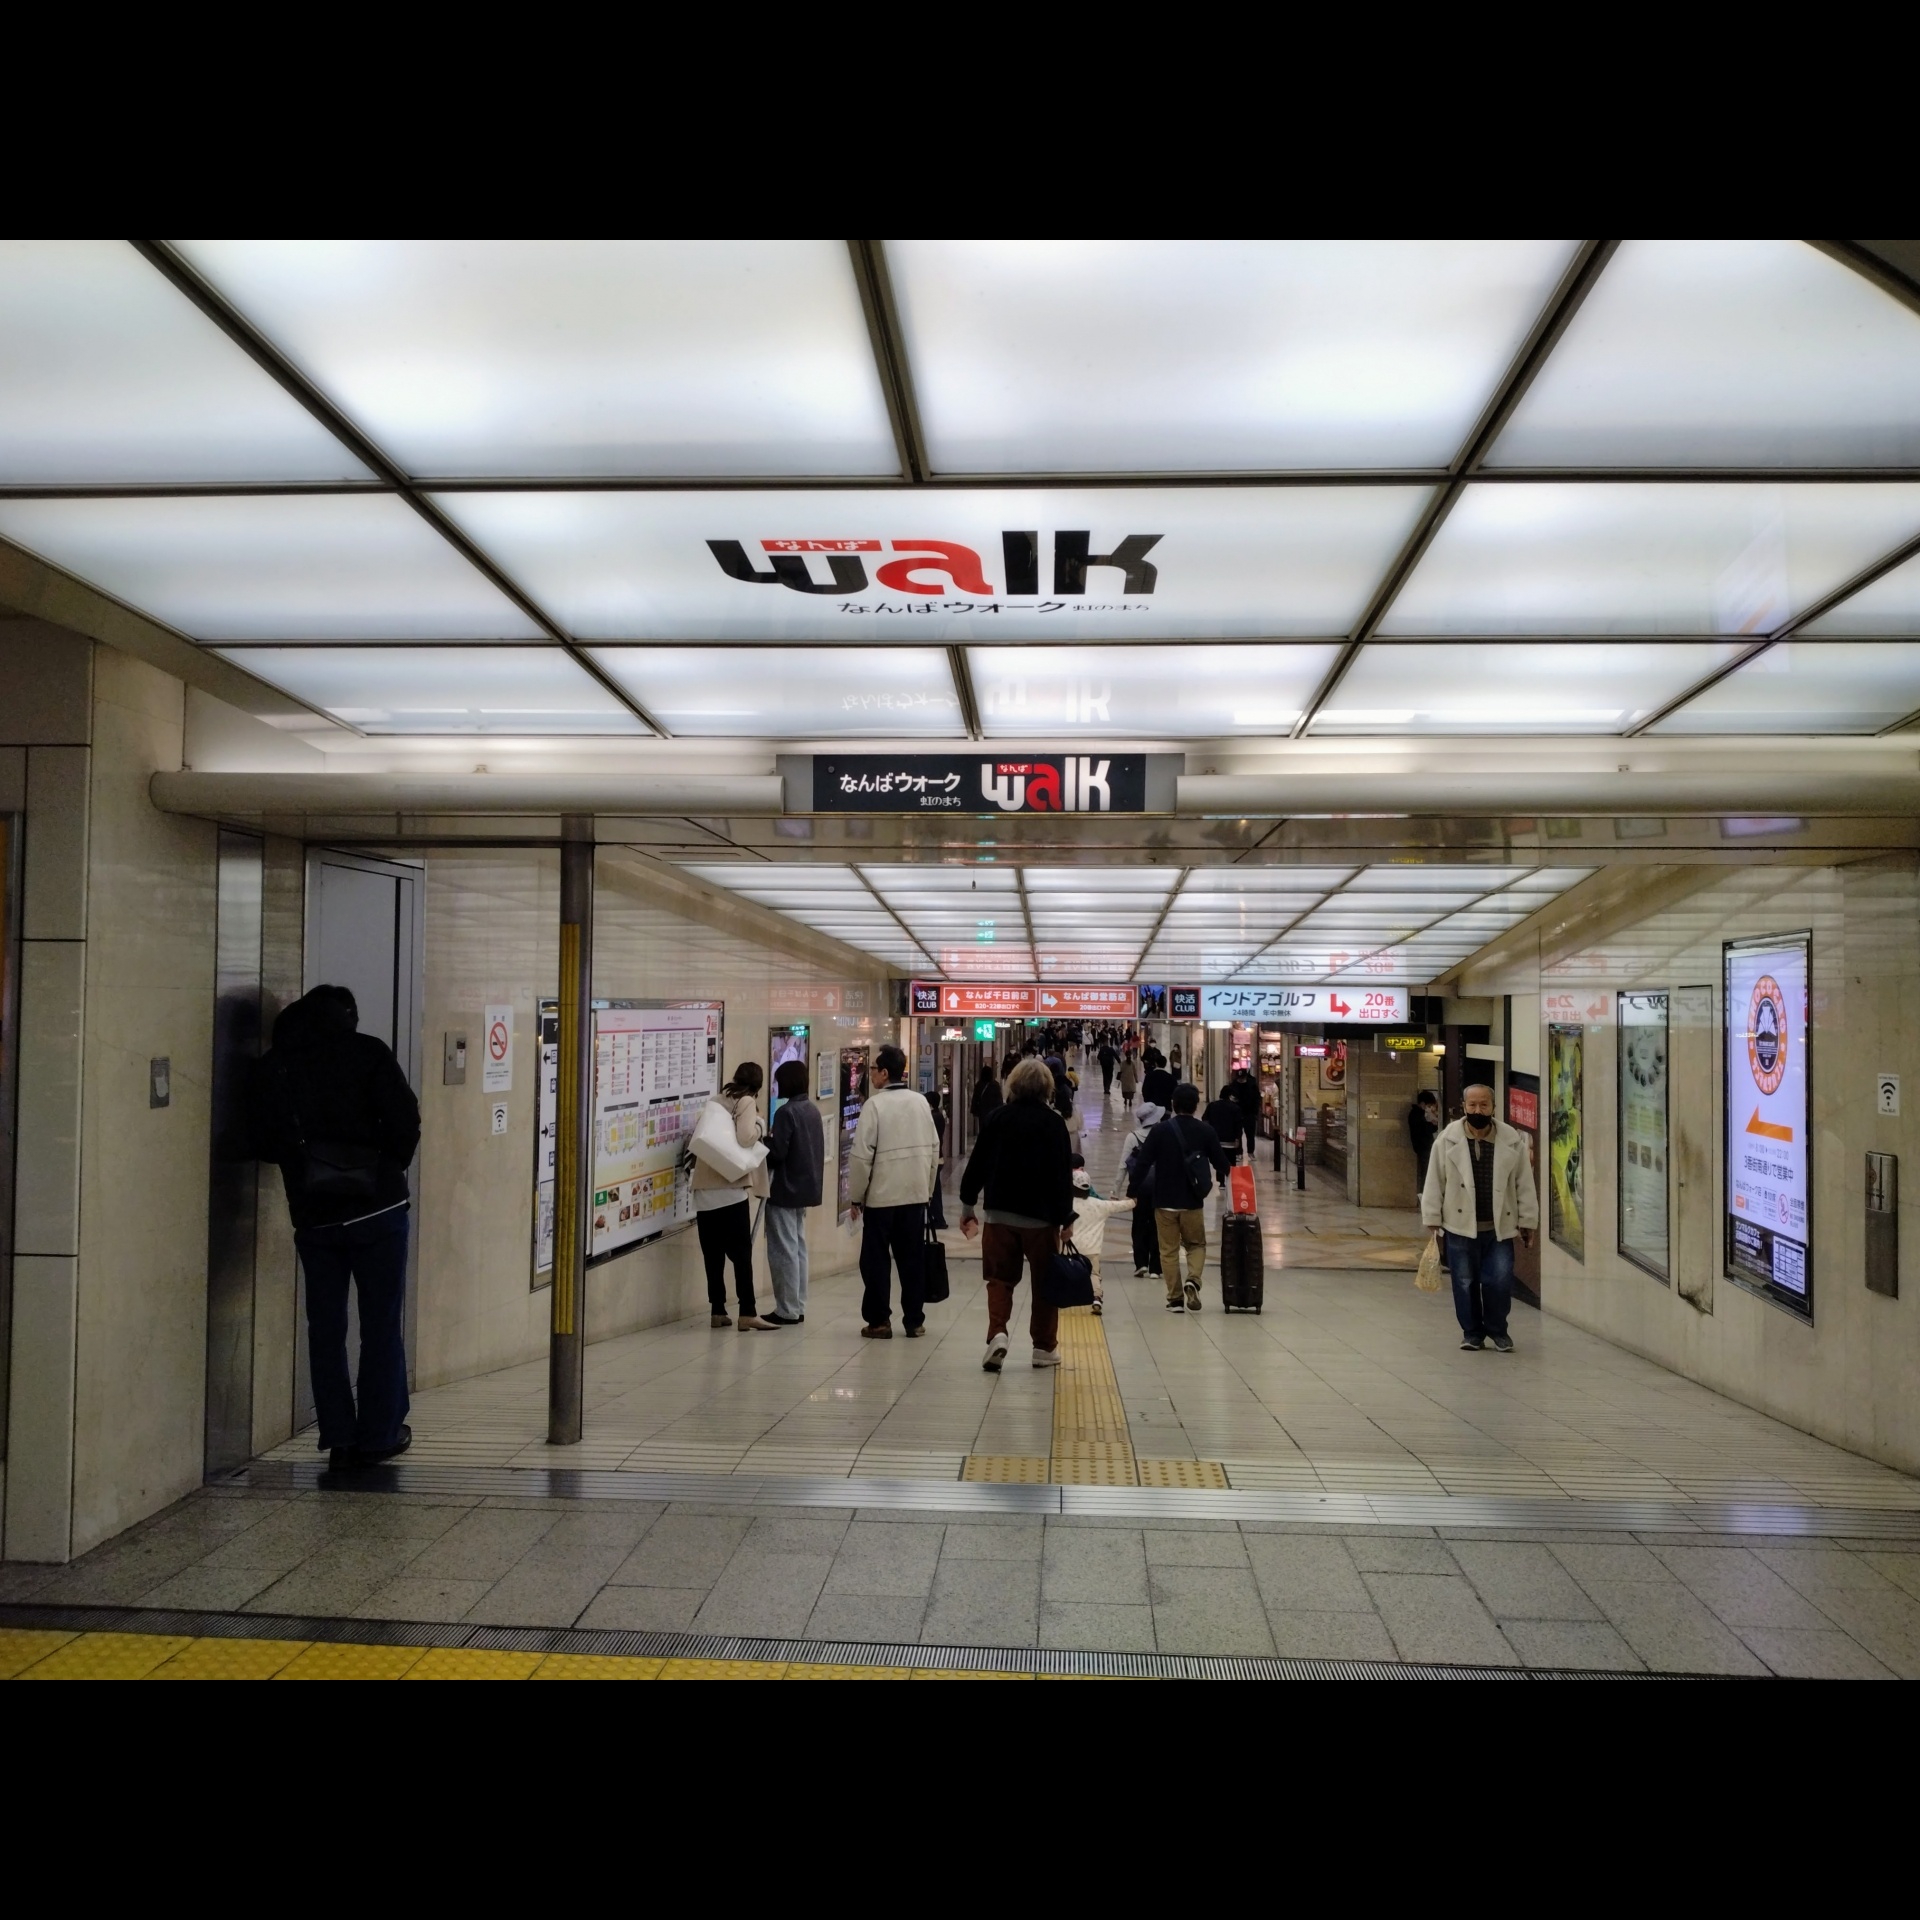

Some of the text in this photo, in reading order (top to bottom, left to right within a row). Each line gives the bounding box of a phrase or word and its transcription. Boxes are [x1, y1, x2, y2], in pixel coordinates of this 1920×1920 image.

[775, 540, 868, 551] なんば
[836, 600, 1150, 614] なんばウォーク 虹のまち
[1000, 764, 1028, 773] なんば
[840, 772, 961, 793] なんばウォーク
[920, 796, 962, 807] 虹のまち
[917, 990, 937, 1000] 快活
[965, 991, 1029, 1000] なんば千日前店
[1063, 992, 1127, 1002] なんば御堂筋店
[1174, 993, 1196, 1004] 快活
[1208, 991, 1316, 1007] インドアゴルフ
[1365, 993, 1395, 1006] 20番
[917, 1001, 937, 1009] CLUB
[1175, 1004, 1196, 1012] CLUB
[1232, 1009, 1292, 1017] 24時間 年中無休
[1359, 1008, 1401, 1018] 出口すぐ
[1387, 1038, 1423, 1046] サンマルコ
